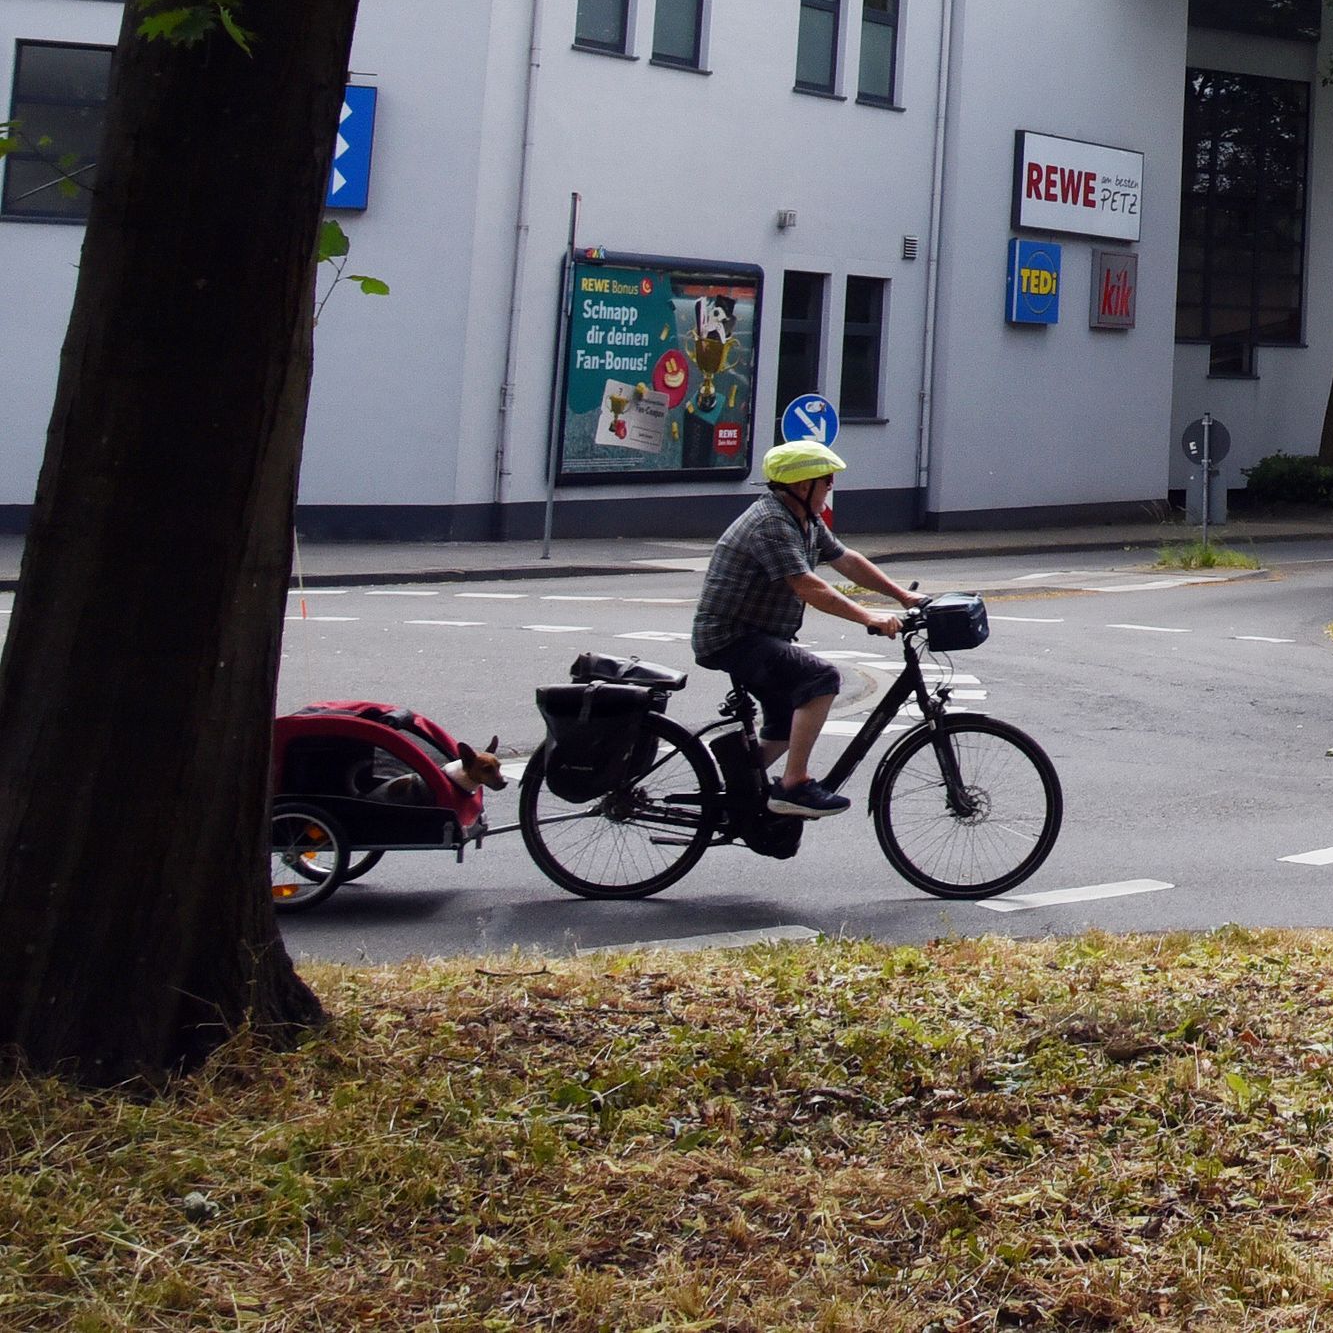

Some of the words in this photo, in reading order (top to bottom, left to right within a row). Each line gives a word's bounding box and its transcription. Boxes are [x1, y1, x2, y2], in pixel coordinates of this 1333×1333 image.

[1026, 162, 1097, 208] REWE
[1101, 176, 1112, 185] am
[1114, 174, 1139, 189] besten
[1101, 188, 1138, 214] PETZ
[581, 278, 610, 293] REWE
[611, 281, 639, 296] Bonus
[1020, 268, 1057, 295] TEDi
[582, 299, 638, 325] Schnapp
[586, 325, 605, 345] dir
[606, 326, 649, 347] deinen
[718, 429, 738, 439] REWE
